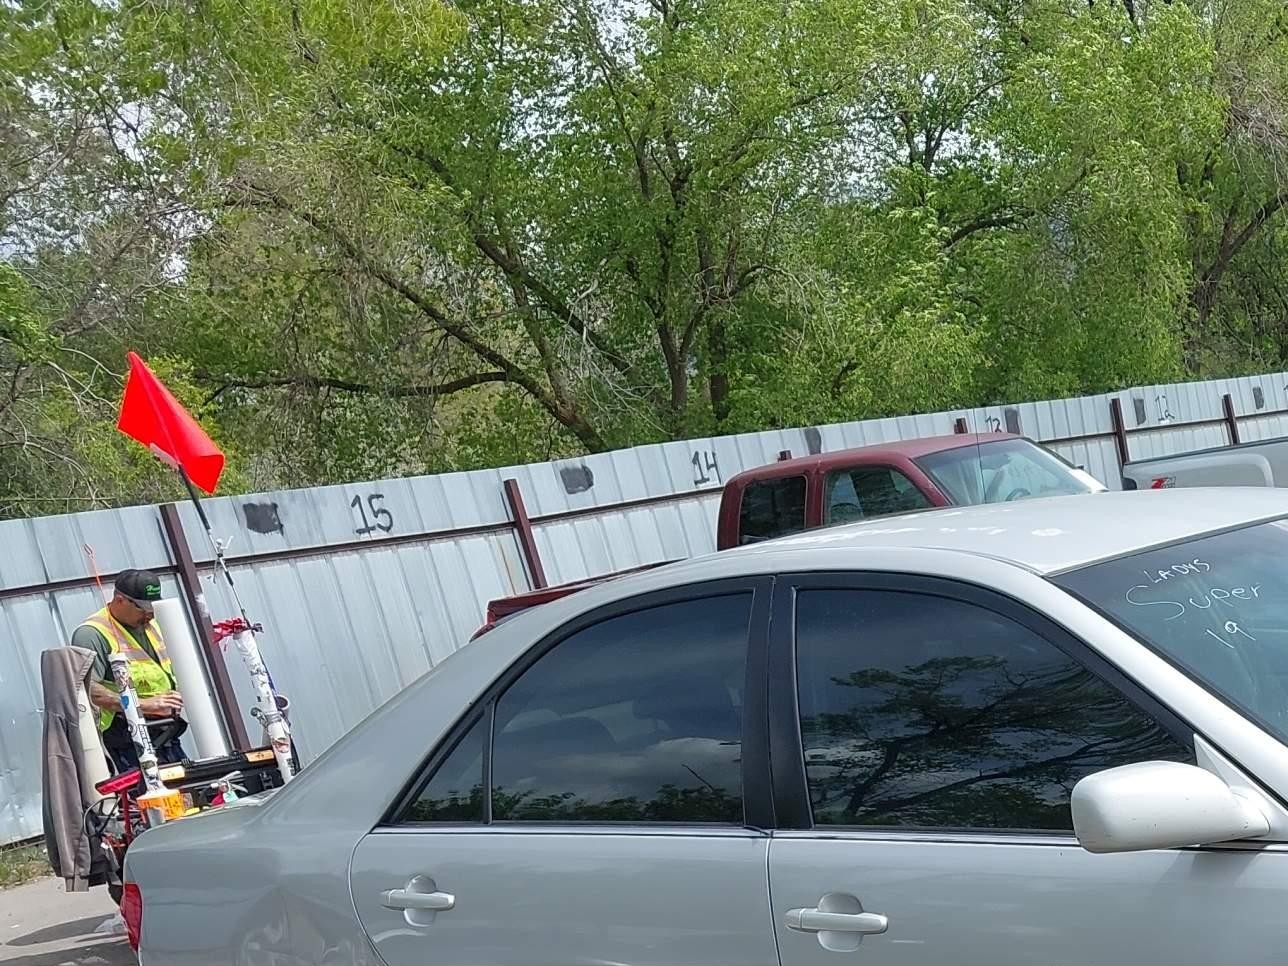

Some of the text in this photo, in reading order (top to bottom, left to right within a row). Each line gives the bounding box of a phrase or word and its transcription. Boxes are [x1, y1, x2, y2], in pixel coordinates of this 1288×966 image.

[692, 450, 721, 486] 14
[351, 494, 394, 535] 15
[1205, 620, 1257, 649] 19
